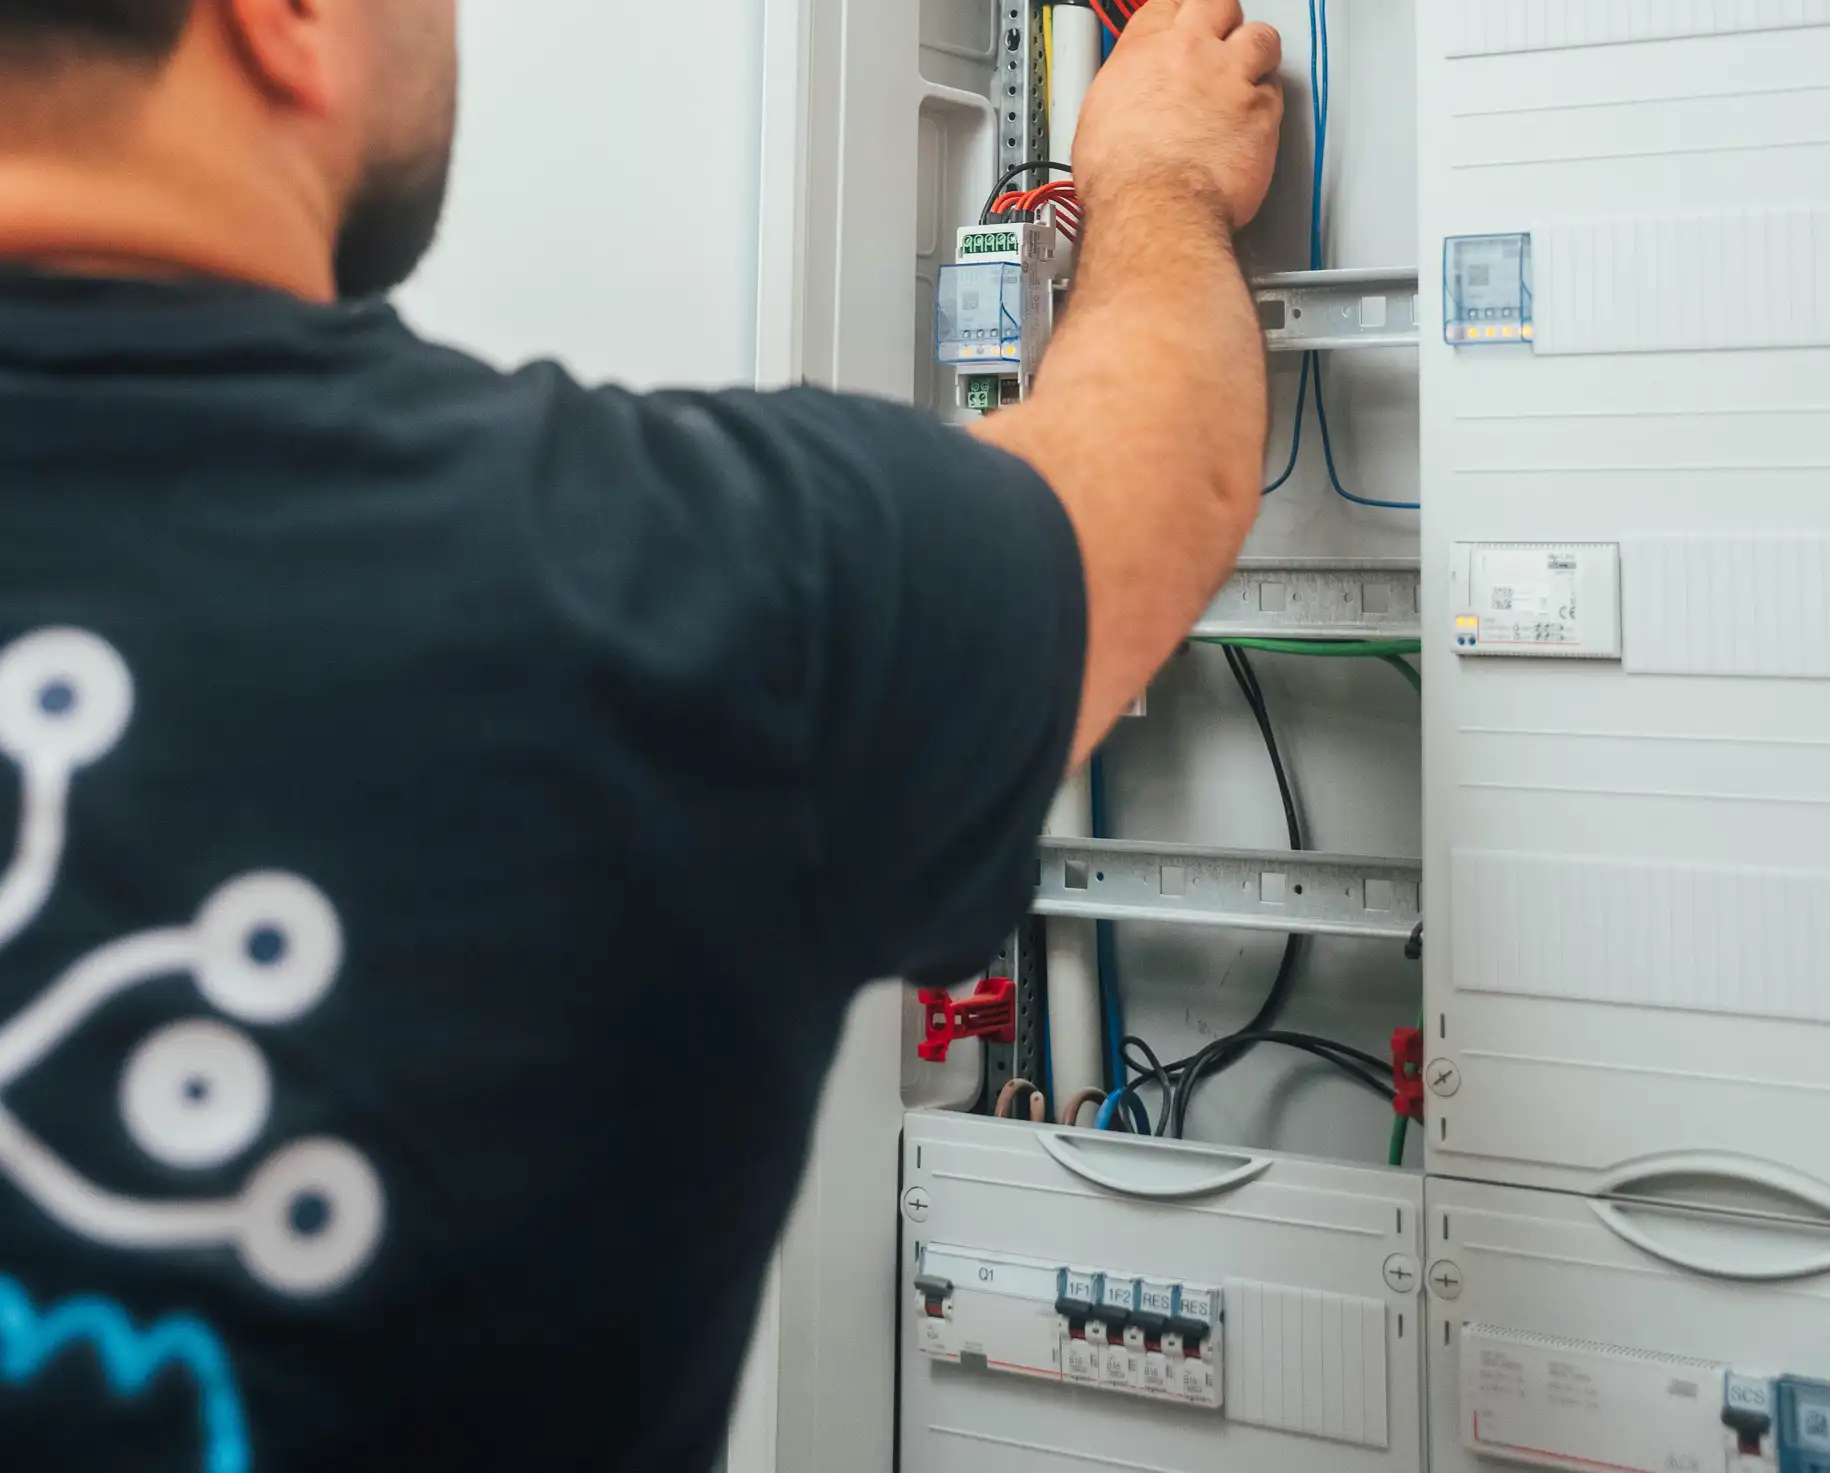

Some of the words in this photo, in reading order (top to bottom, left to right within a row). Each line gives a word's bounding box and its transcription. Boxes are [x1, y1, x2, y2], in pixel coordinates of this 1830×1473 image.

[979, 1267, 994, 1282] Q1
[1069, 1282, 1090, 1296] 1F1
[1109, 1288, 1131, 1302] 1F2
[1730, 1385, 1765, 1404] SCS
